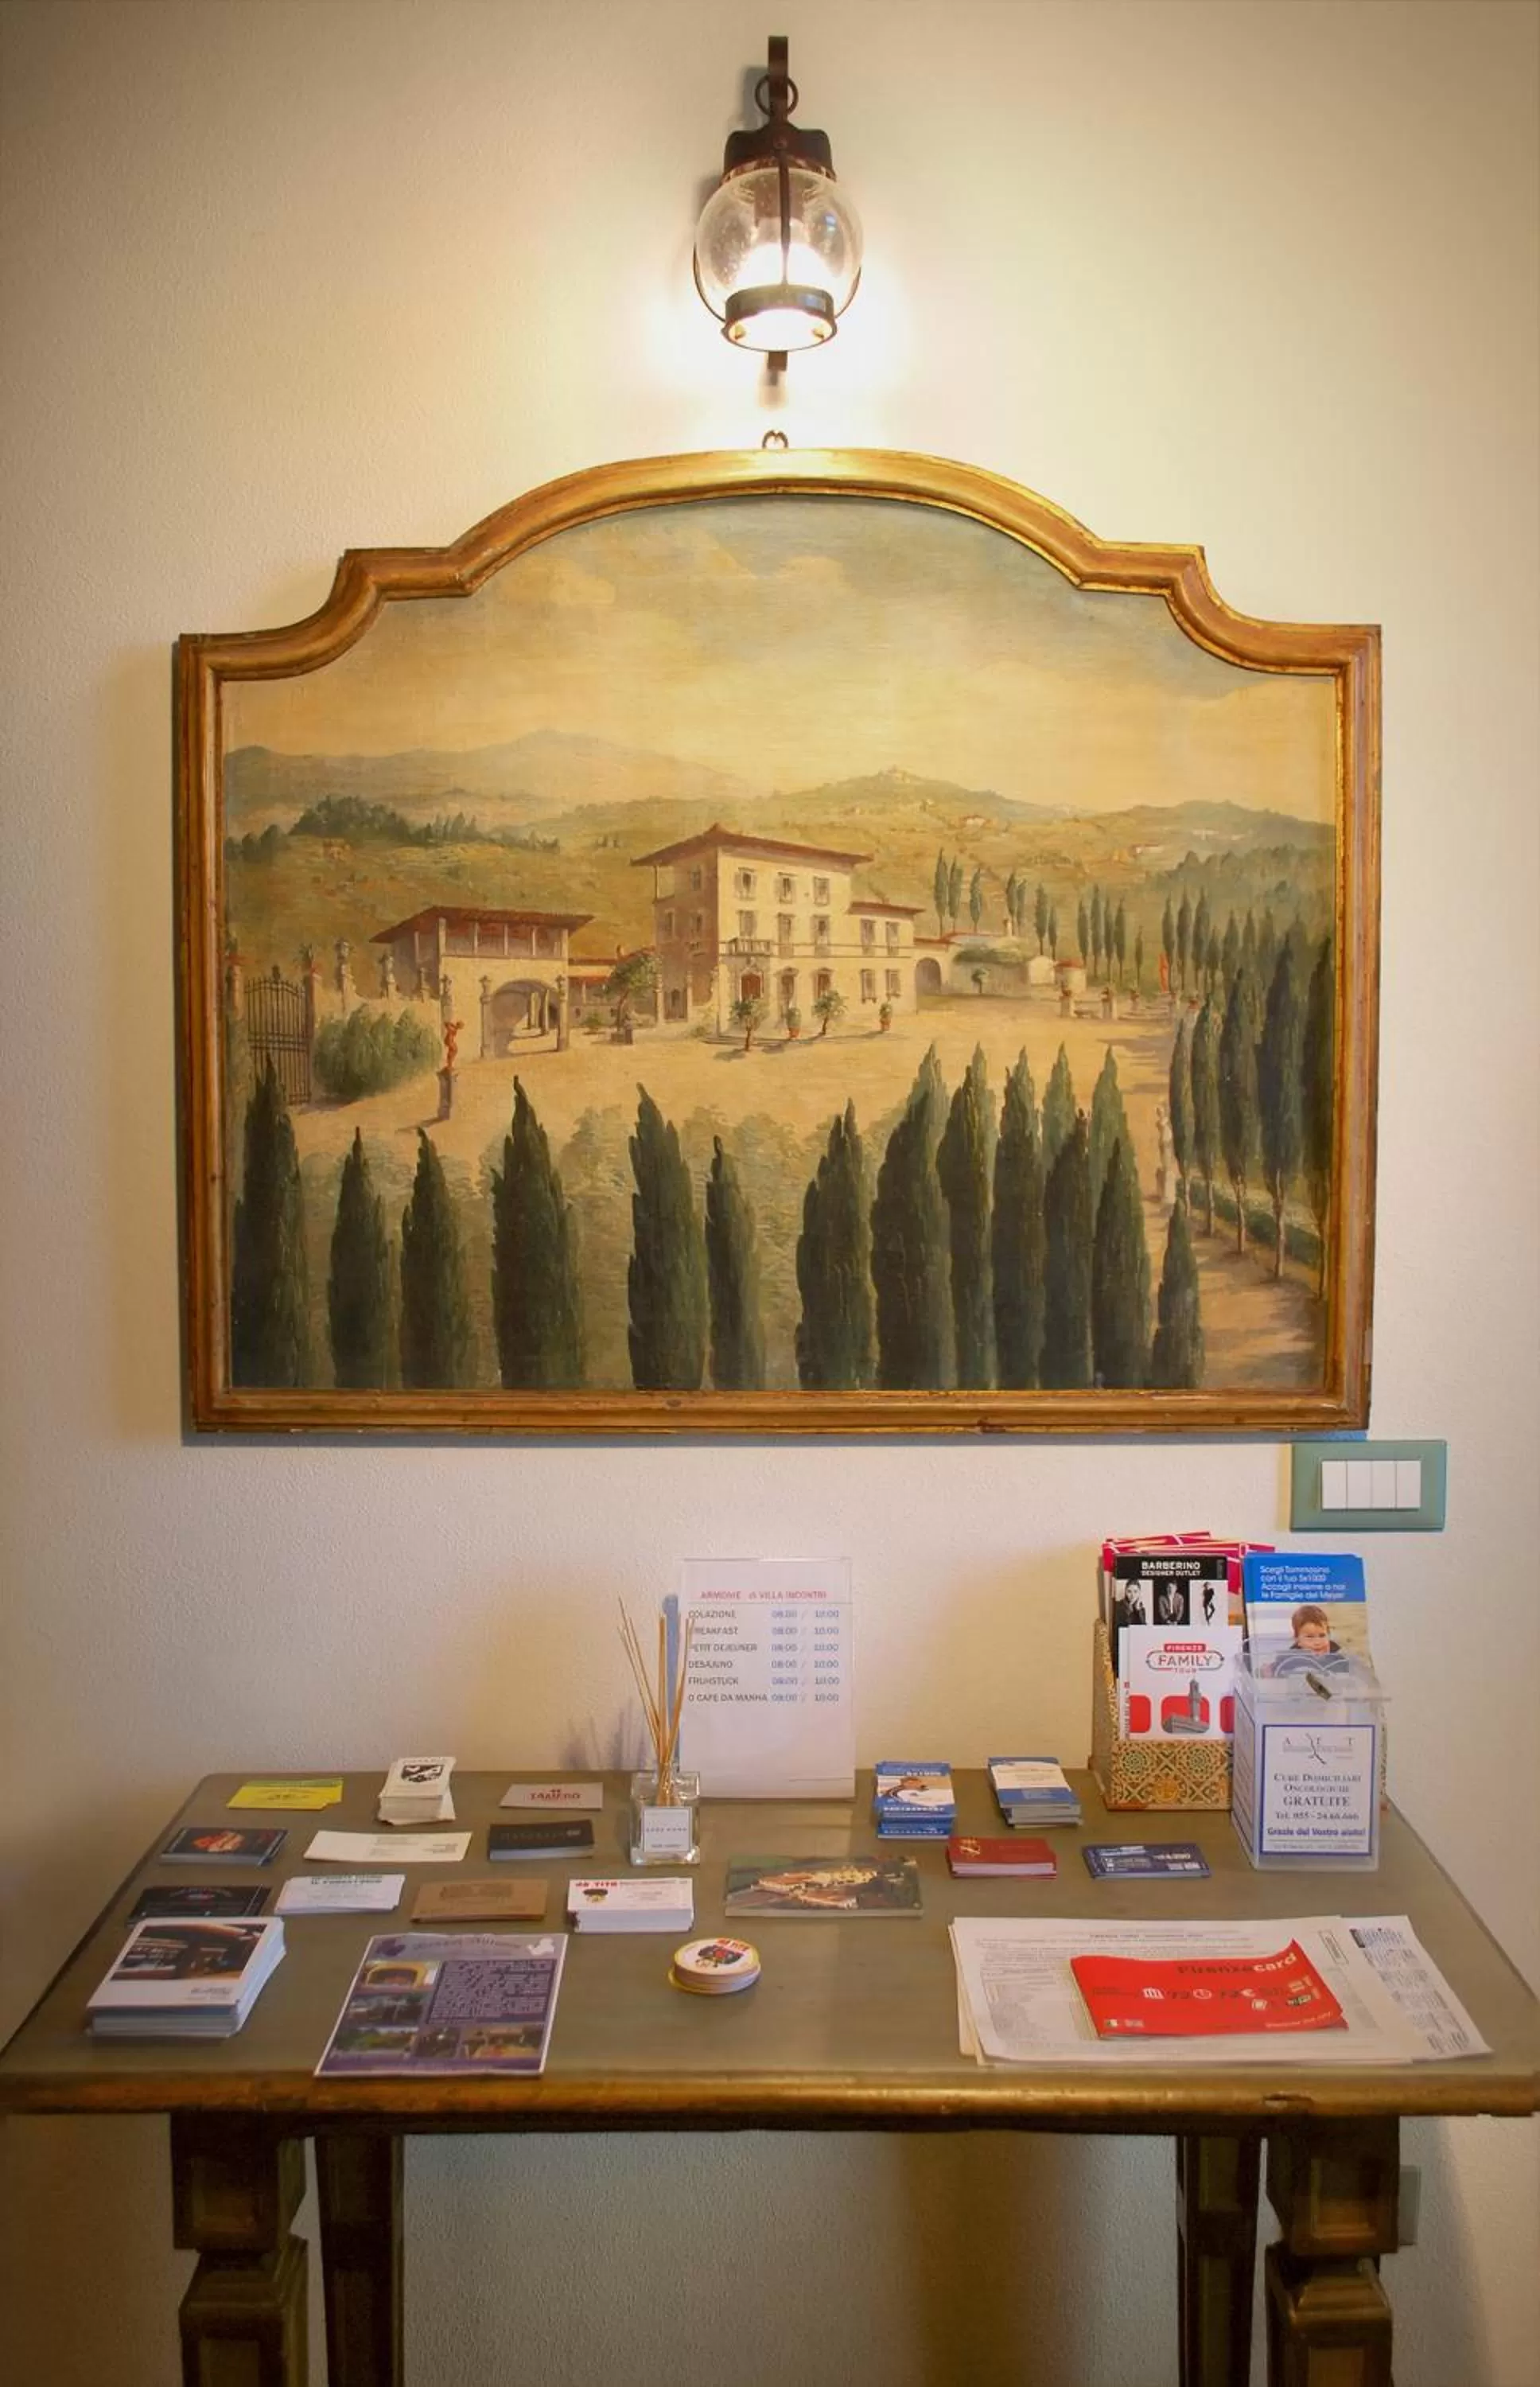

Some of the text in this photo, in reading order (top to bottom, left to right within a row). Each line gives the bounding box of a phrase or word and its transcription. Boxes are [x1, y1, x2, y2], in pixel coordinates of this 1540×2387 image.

[1141, 1561, 1200, 1570] BARBERINO
[688, 1610, 737, 1618] COLAZIONE
[689, 1626, 738, 1635] REAKFAST
[1158, 1655, 1213, 1667] FAMILY
[1283, 1796, 1350, 1806] GRATUITE
